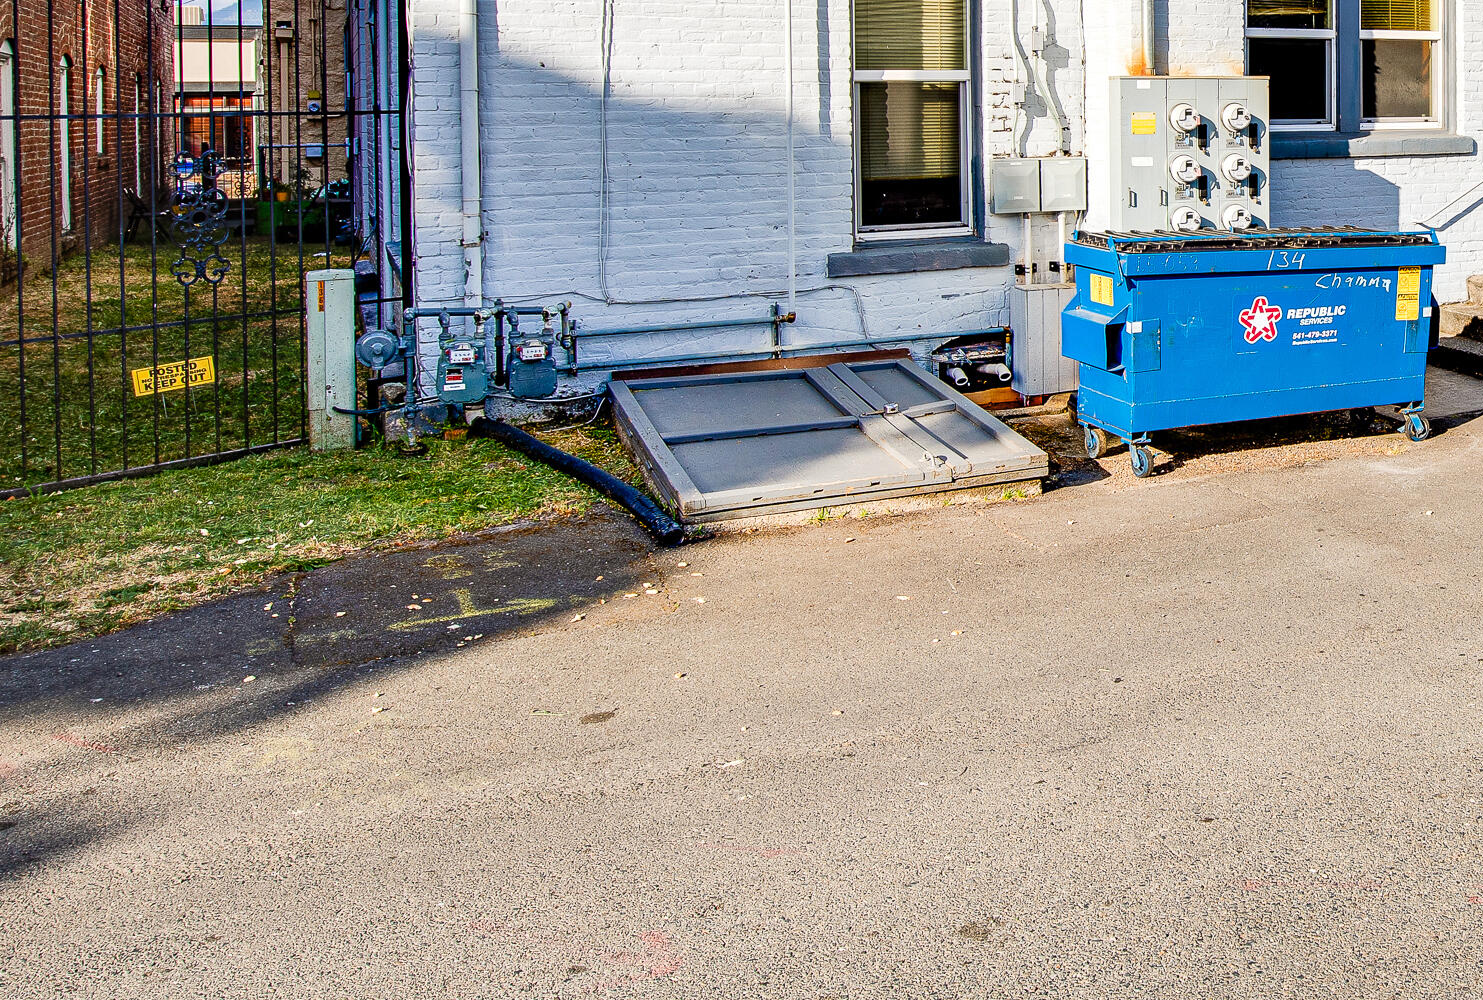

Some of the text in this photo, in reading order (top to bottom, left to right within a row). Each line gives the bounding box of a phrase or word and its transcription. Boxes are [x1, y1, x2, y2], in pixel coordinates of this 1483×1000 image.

[1267, 250, 1306, 271] 134
[1287, 305, 1346, 319] REPUBLIC
[1300, 317, 1333, 326] SERVICES
[149, 362, 197, 378] POSTED
[144, 378, 177, 391] KEEP
